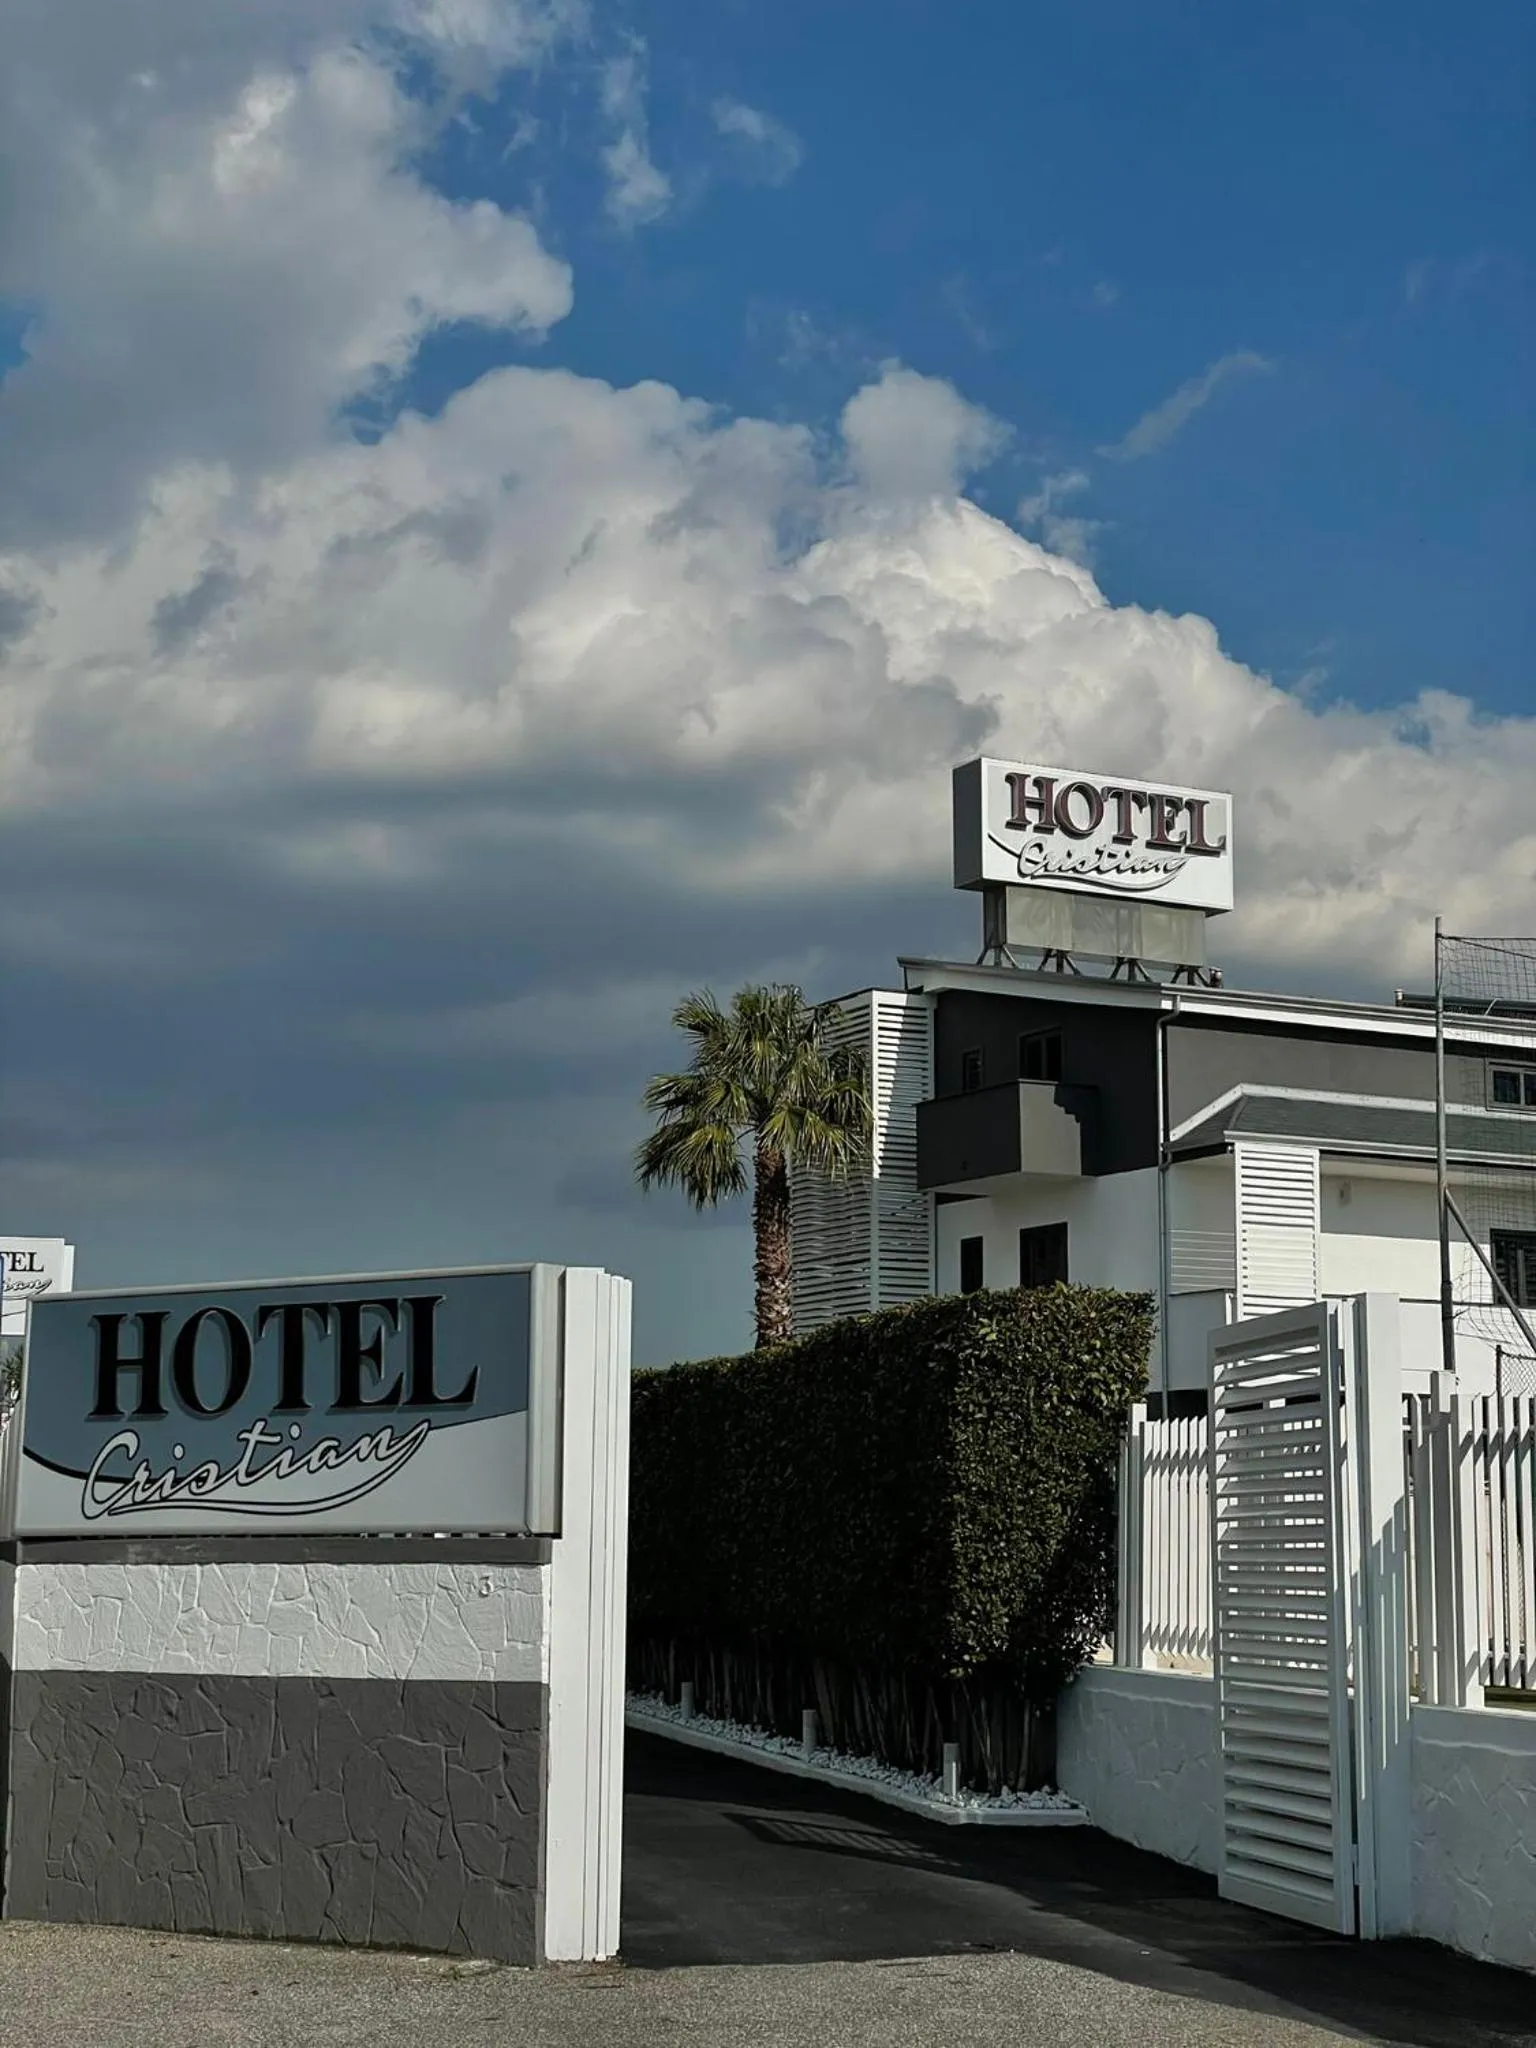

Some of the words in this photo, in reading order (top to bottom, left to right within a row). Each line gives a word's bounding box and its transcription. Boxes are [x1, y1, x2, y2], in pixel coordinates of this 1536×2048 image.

[1004, 772, 1227, 857] HOTEL
[86, 1295, 479, 1420] HOTEL
[81, 1419, 431, 1520] Cristian
